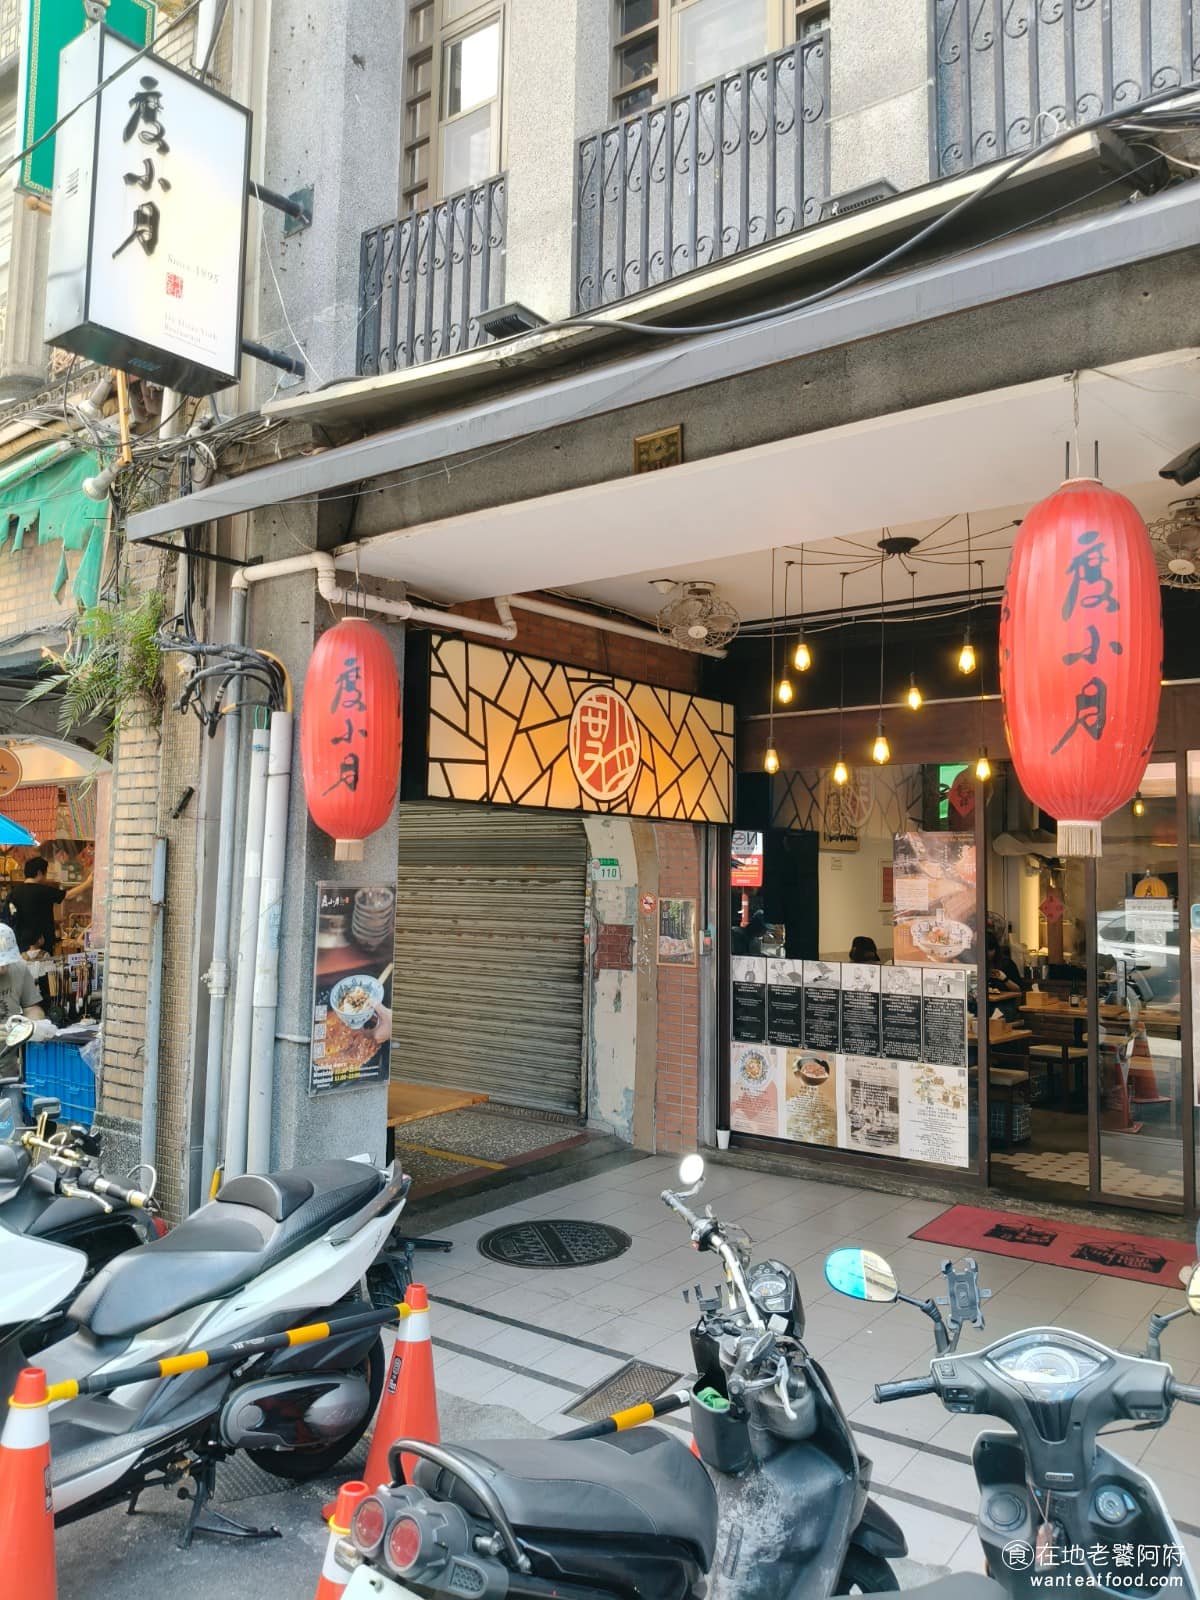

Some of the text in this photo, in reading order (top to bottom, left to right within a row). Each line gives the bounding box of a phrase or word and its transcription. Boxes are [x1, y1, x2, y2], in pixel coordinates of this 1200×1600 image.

[112, 75, 172, 260] 度小月
[1051, 531, 1123, 755] 度小月
[322, 658, 367, 797] 度小月
[601, 868, 617, 878] 110
